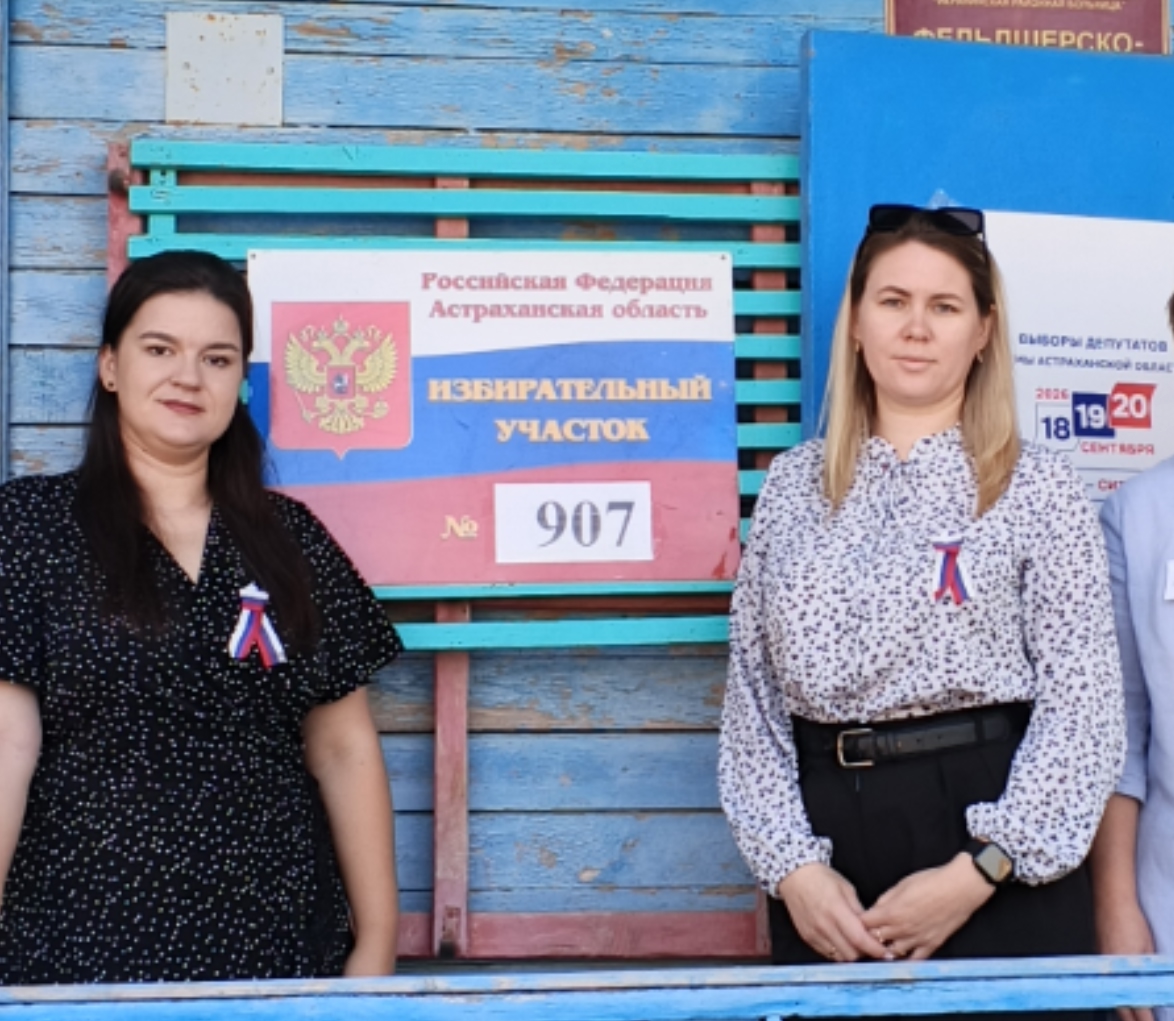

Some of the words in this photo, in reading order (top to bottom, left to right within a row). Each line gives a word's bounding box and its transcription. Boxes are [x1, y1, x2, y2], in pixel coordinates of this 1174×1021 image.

[421, 272, 567, 291] Российская
[575, 272, 713, 294] Федерация
[429, 299, 604, 322] Астраханская
[612, 299, 708, 319] область
[1019, 333, 1082, 347] ВЫБОРЫ
[1085, 336, 1168, 352] ДЕПУТАТОВ
[1038, 356, 1131, 371] АСТРАХАНСКОЙ
[428, 374, 712, 401] ИЗБИРАТЕЛЬНЫЙ
[1041, 416, 1070, 440] 18
[1075, 403, 1106, 429] 19
[1112, 392, 1147, 419] 20
[494, 418, 650, 442] УЧАСТОК
[1081, 441, 1155, 456] СЕНТЯБРЯ
[441, 515, 478, 539] №
[536, 499, 635, 548] 907
